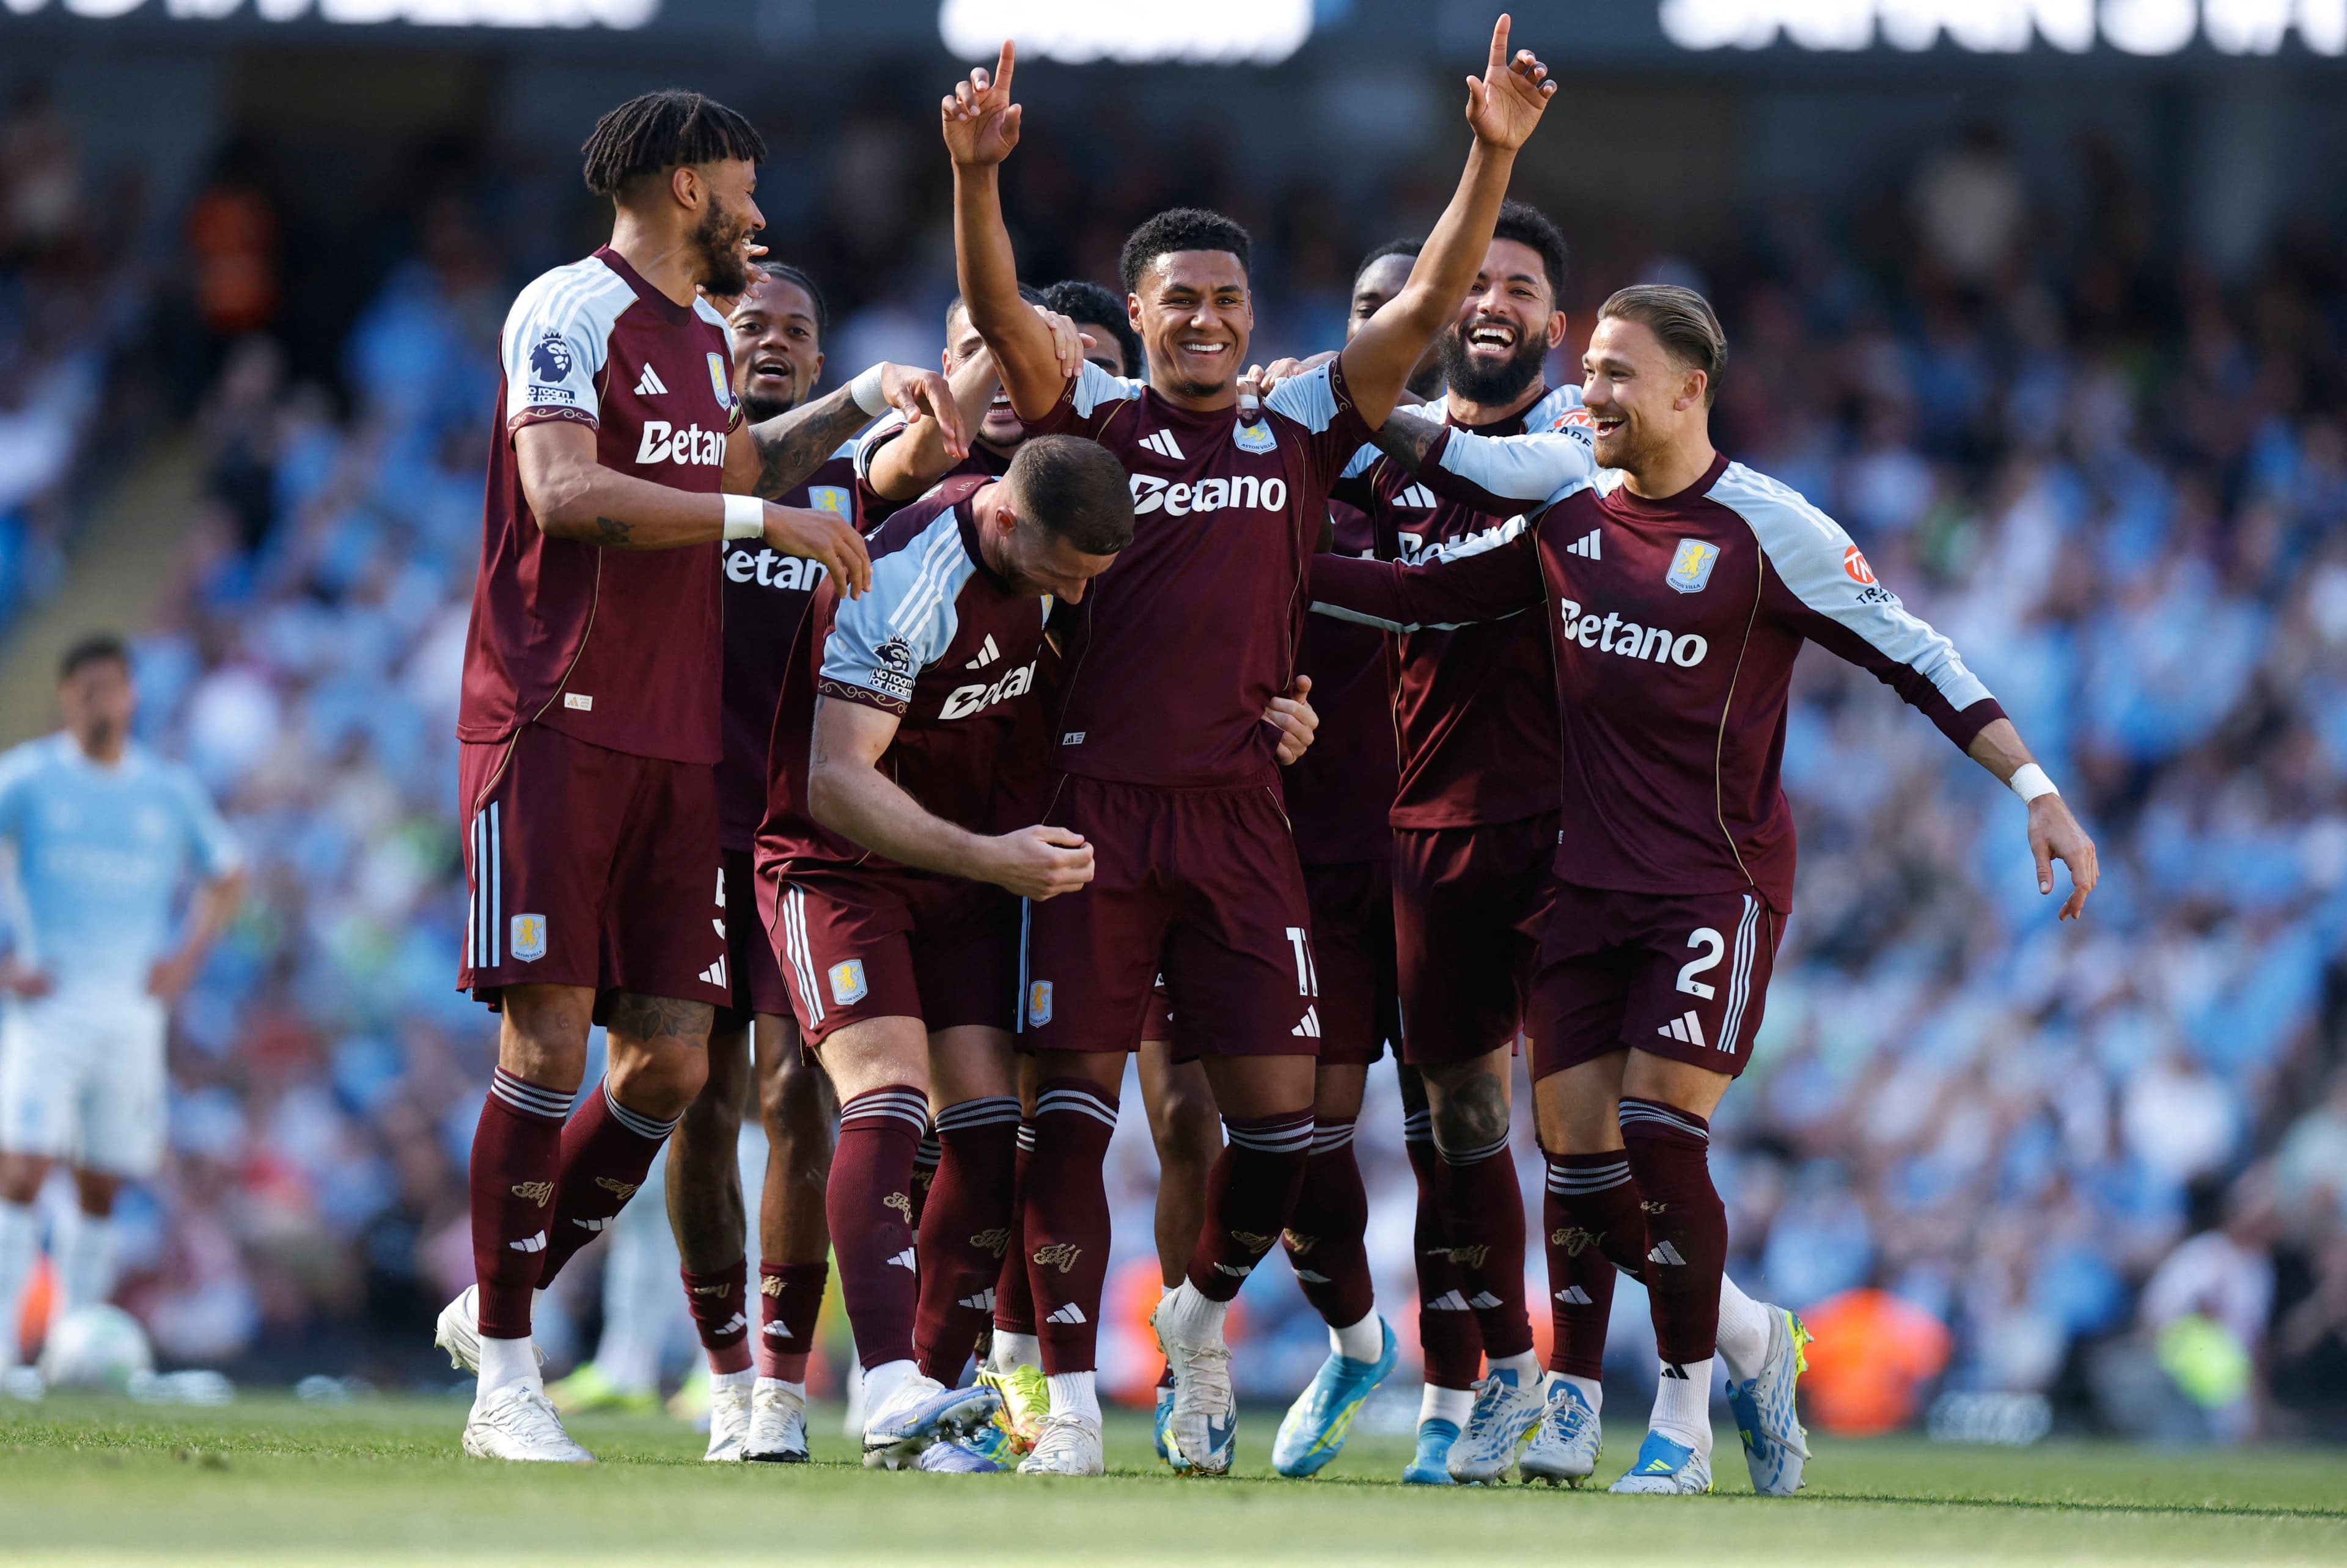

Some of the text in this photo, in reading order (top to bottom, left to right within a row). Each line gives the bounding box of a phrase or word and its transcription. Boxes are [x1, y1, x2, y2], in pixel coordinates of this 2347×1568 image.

[538, 387, 570, 398] room
[635, 420, 727, 468] Betan
[1129, 473, 1287, 516] Betano
[722, 540, 829, 591] etan
[1669, 577, 1685, 588] ASTON
[1562, 598, 1708, 667] Betano
[872, 668, 913, 689] No room
[938, 659, 1037, 719] Beta
[1676, 927, 1724, 1000] 2
